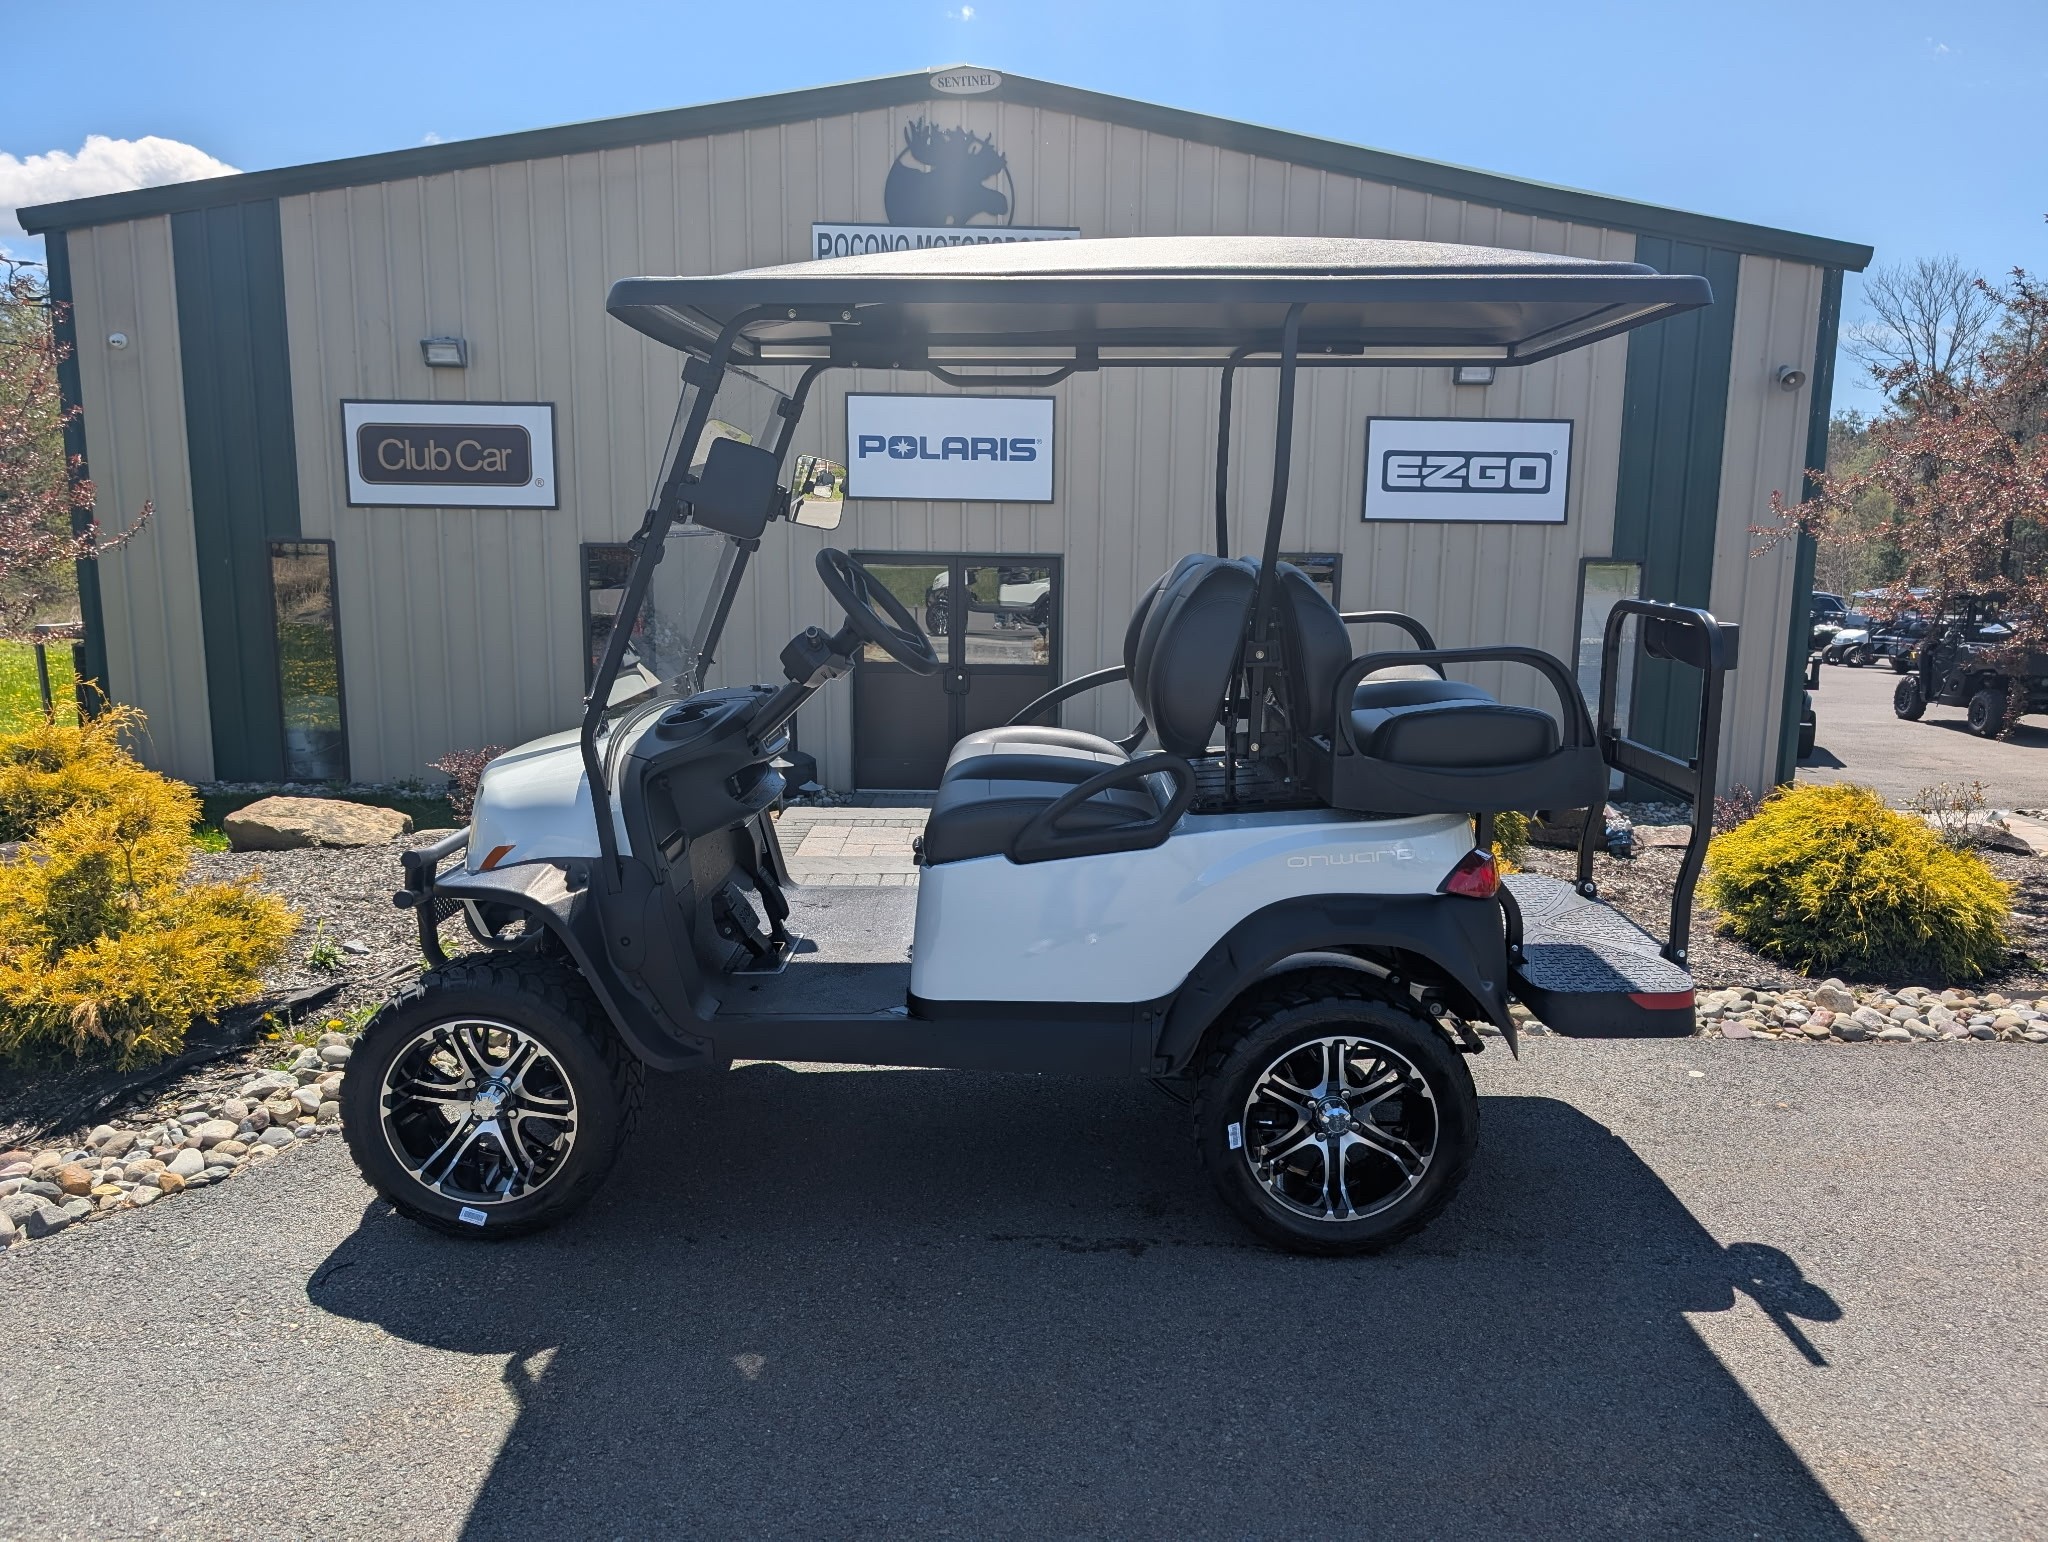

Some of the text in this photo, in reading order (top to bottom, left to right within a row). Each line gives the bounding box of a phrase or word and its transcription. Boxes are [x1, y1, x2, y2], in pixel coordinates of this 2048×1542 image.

[938, 75, 995, 88] SENTINEL
[817, 232, 910, 260] POCONO
[377, 438, 512, 472] Club Car
[858, 434, 1037, 461] POLARIS
